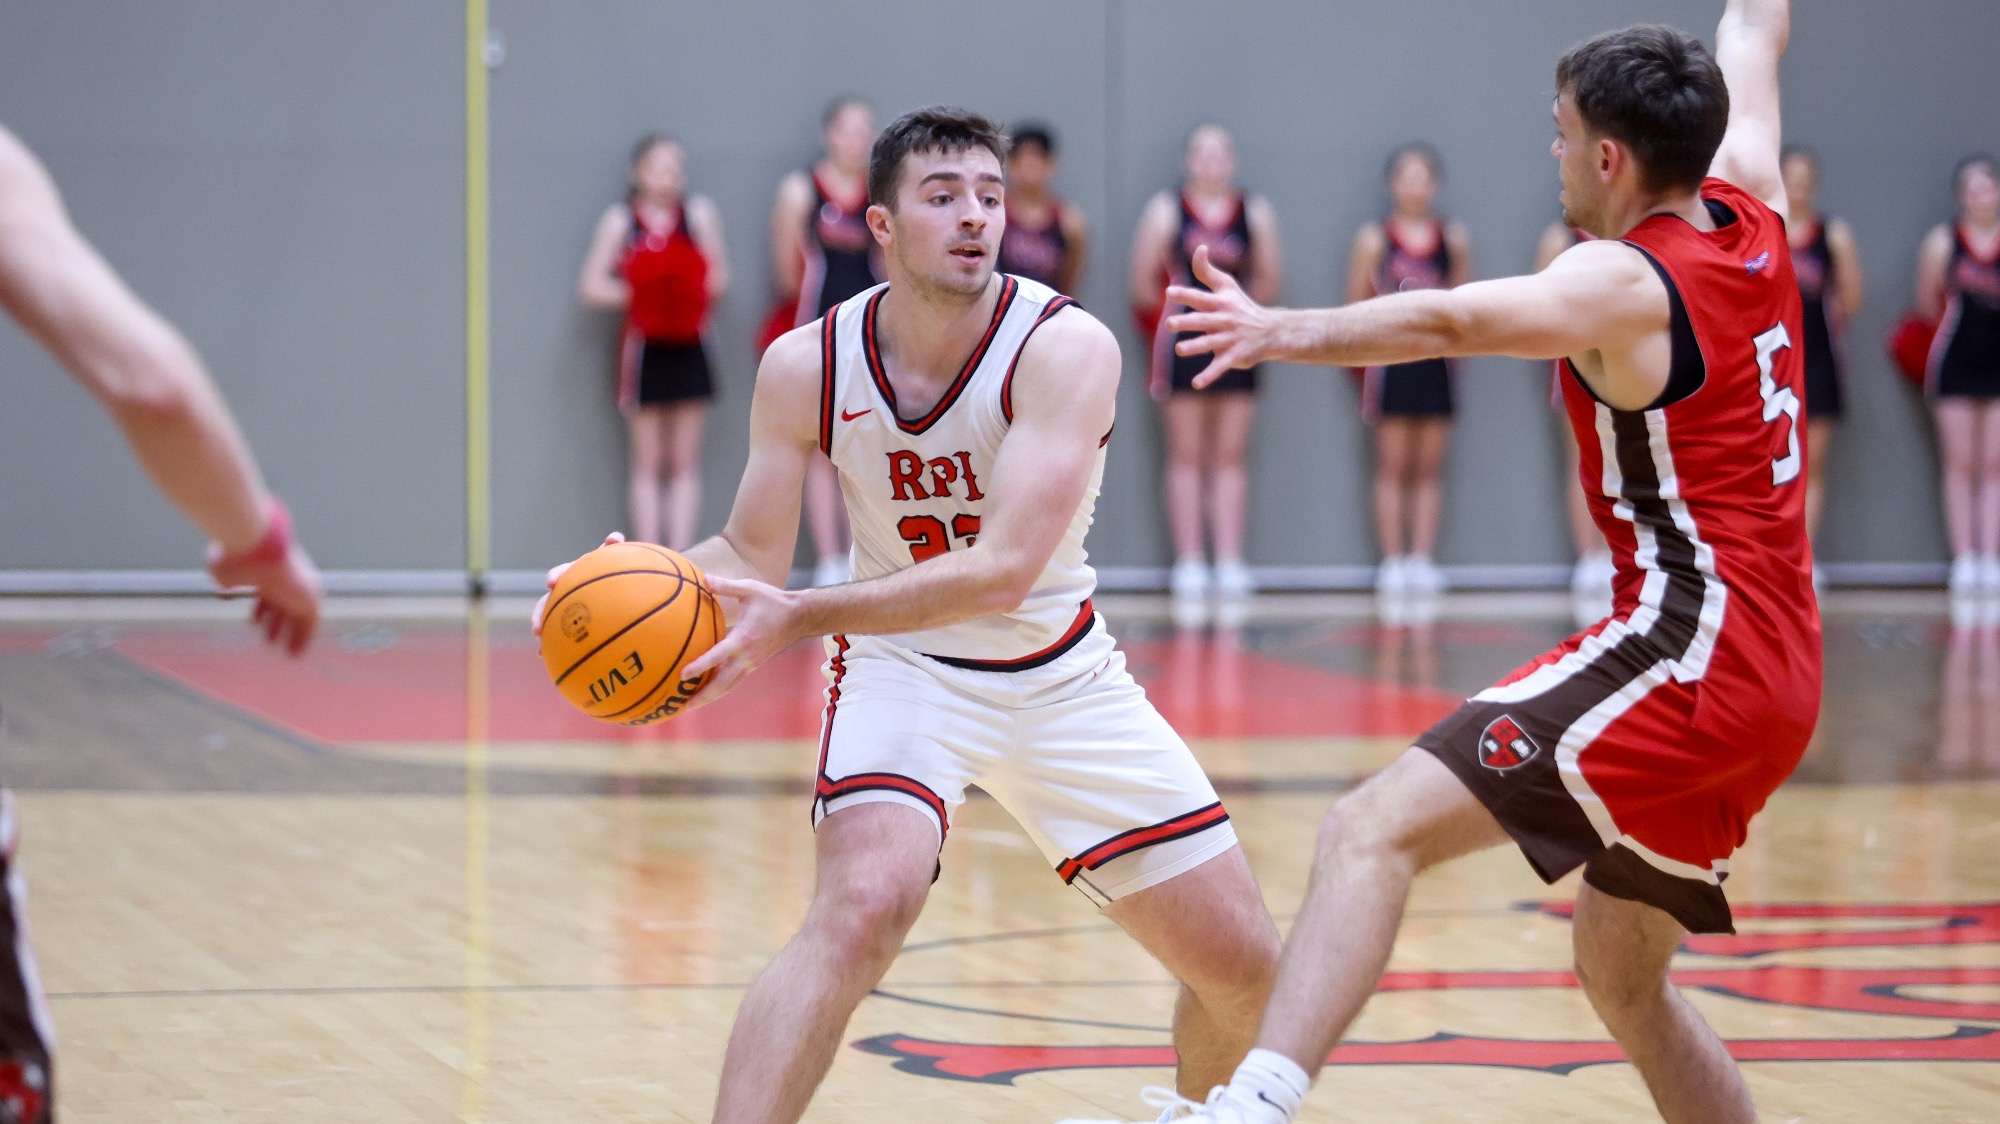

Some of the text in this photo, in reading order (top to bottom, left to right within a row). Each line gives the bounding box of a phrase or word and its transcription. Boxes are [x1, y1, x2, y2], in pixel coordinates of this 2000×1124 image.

[1752, 320, 1801, 487] 5
[885, 449, 985, 502] RPI
[588, 650, 645, 703] EVO
